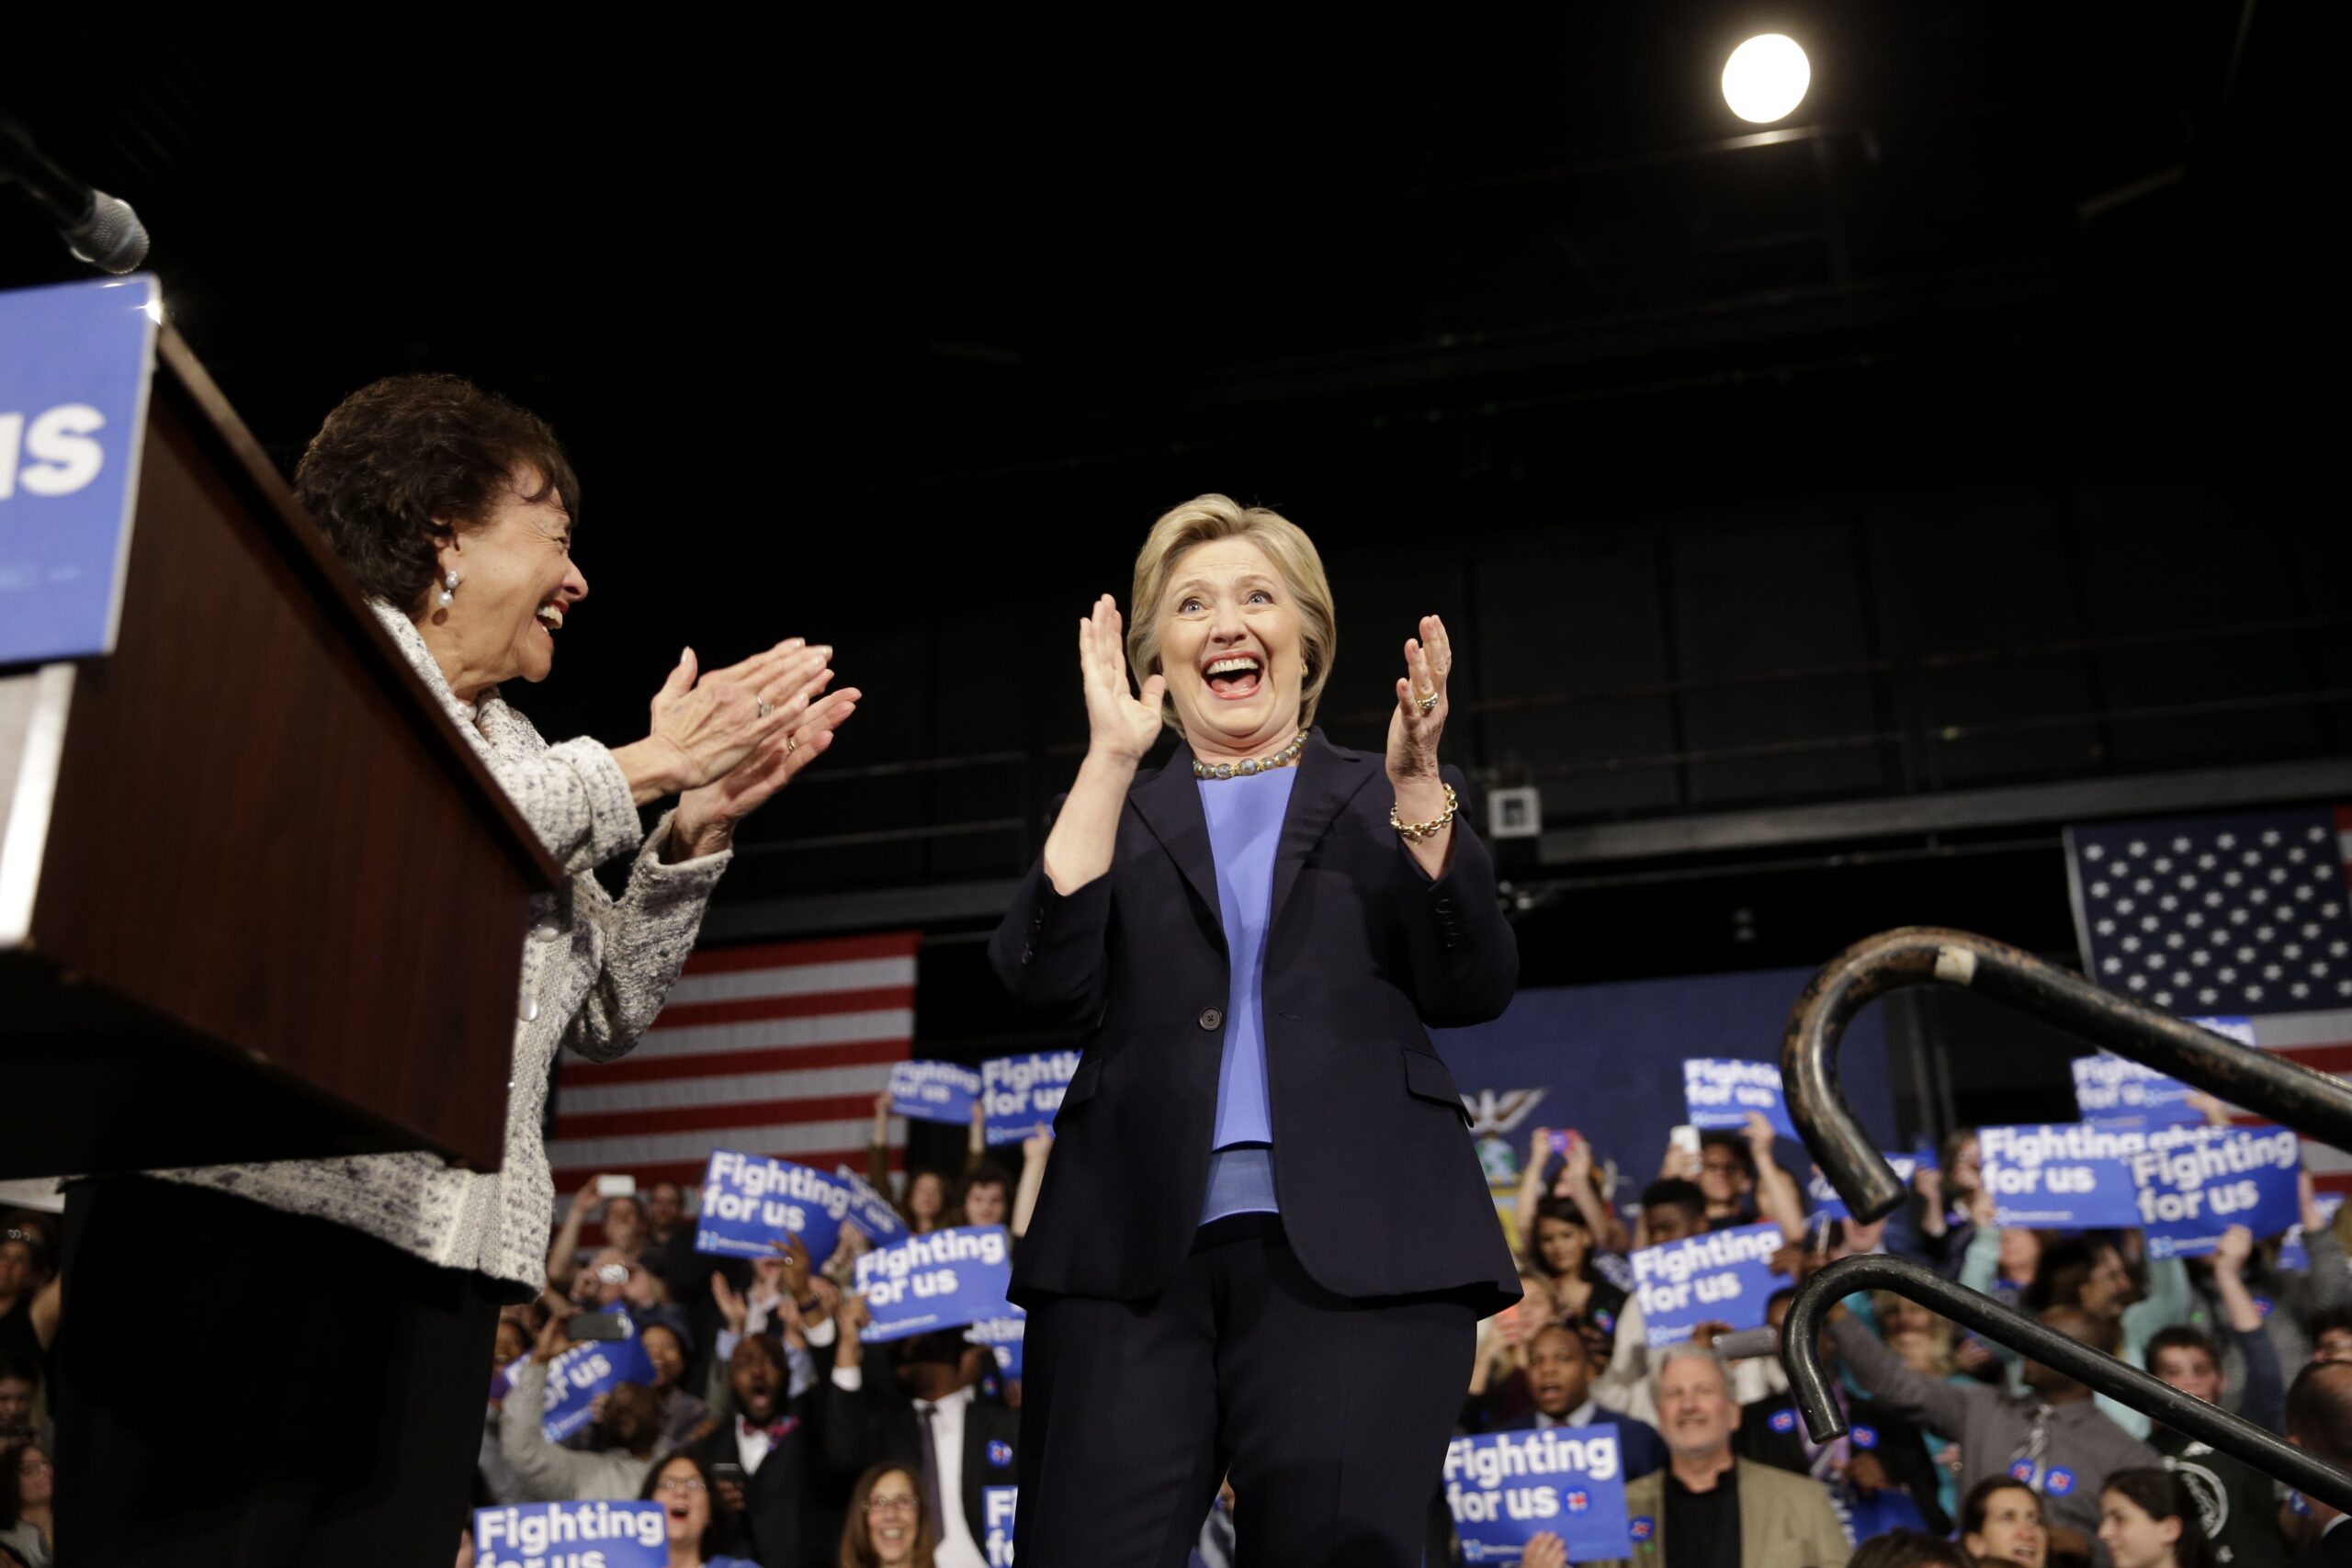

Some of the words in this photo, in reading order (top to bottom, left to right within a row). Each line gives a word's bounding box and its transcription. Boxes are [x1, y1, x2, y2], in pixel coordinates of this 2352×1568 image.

[981, 1051, 1081, 1093] Fighti
[982, 1087, 1030, 1118] for
[1979, 1124, 2147, 1169] Fighting
[2131, 1130, 2299, 1191] Fighting
[709, 1150, 852, 1221] Fighting
[1983, 1159, 2042, 1195] for
[2045, 1166, 2097, 1194] us
[704, 1183, 761, 1224] for
[762, 1200, 807, 1233] us
[2137, 1186, 2203, 1224] for
[2207, 1179, 2260, 1216] us
[855, 1228, 1006, 1280] Fighting
[1632, 1229, 1783, 1283] Fighting
[911, 1268, 959, 1300] us
[1637, 1280, 1691, 1315] for
[1693, 1271, 1743, 1304] us
[568, 1352, 613, 1390] us
[1442, 1429, 1619, 1490] Fighting
[1447, 1481, 1502, 1524] for
[1505, 1484, 1561, 1521] us
[477, 1501, 666, 1557] Fighting
